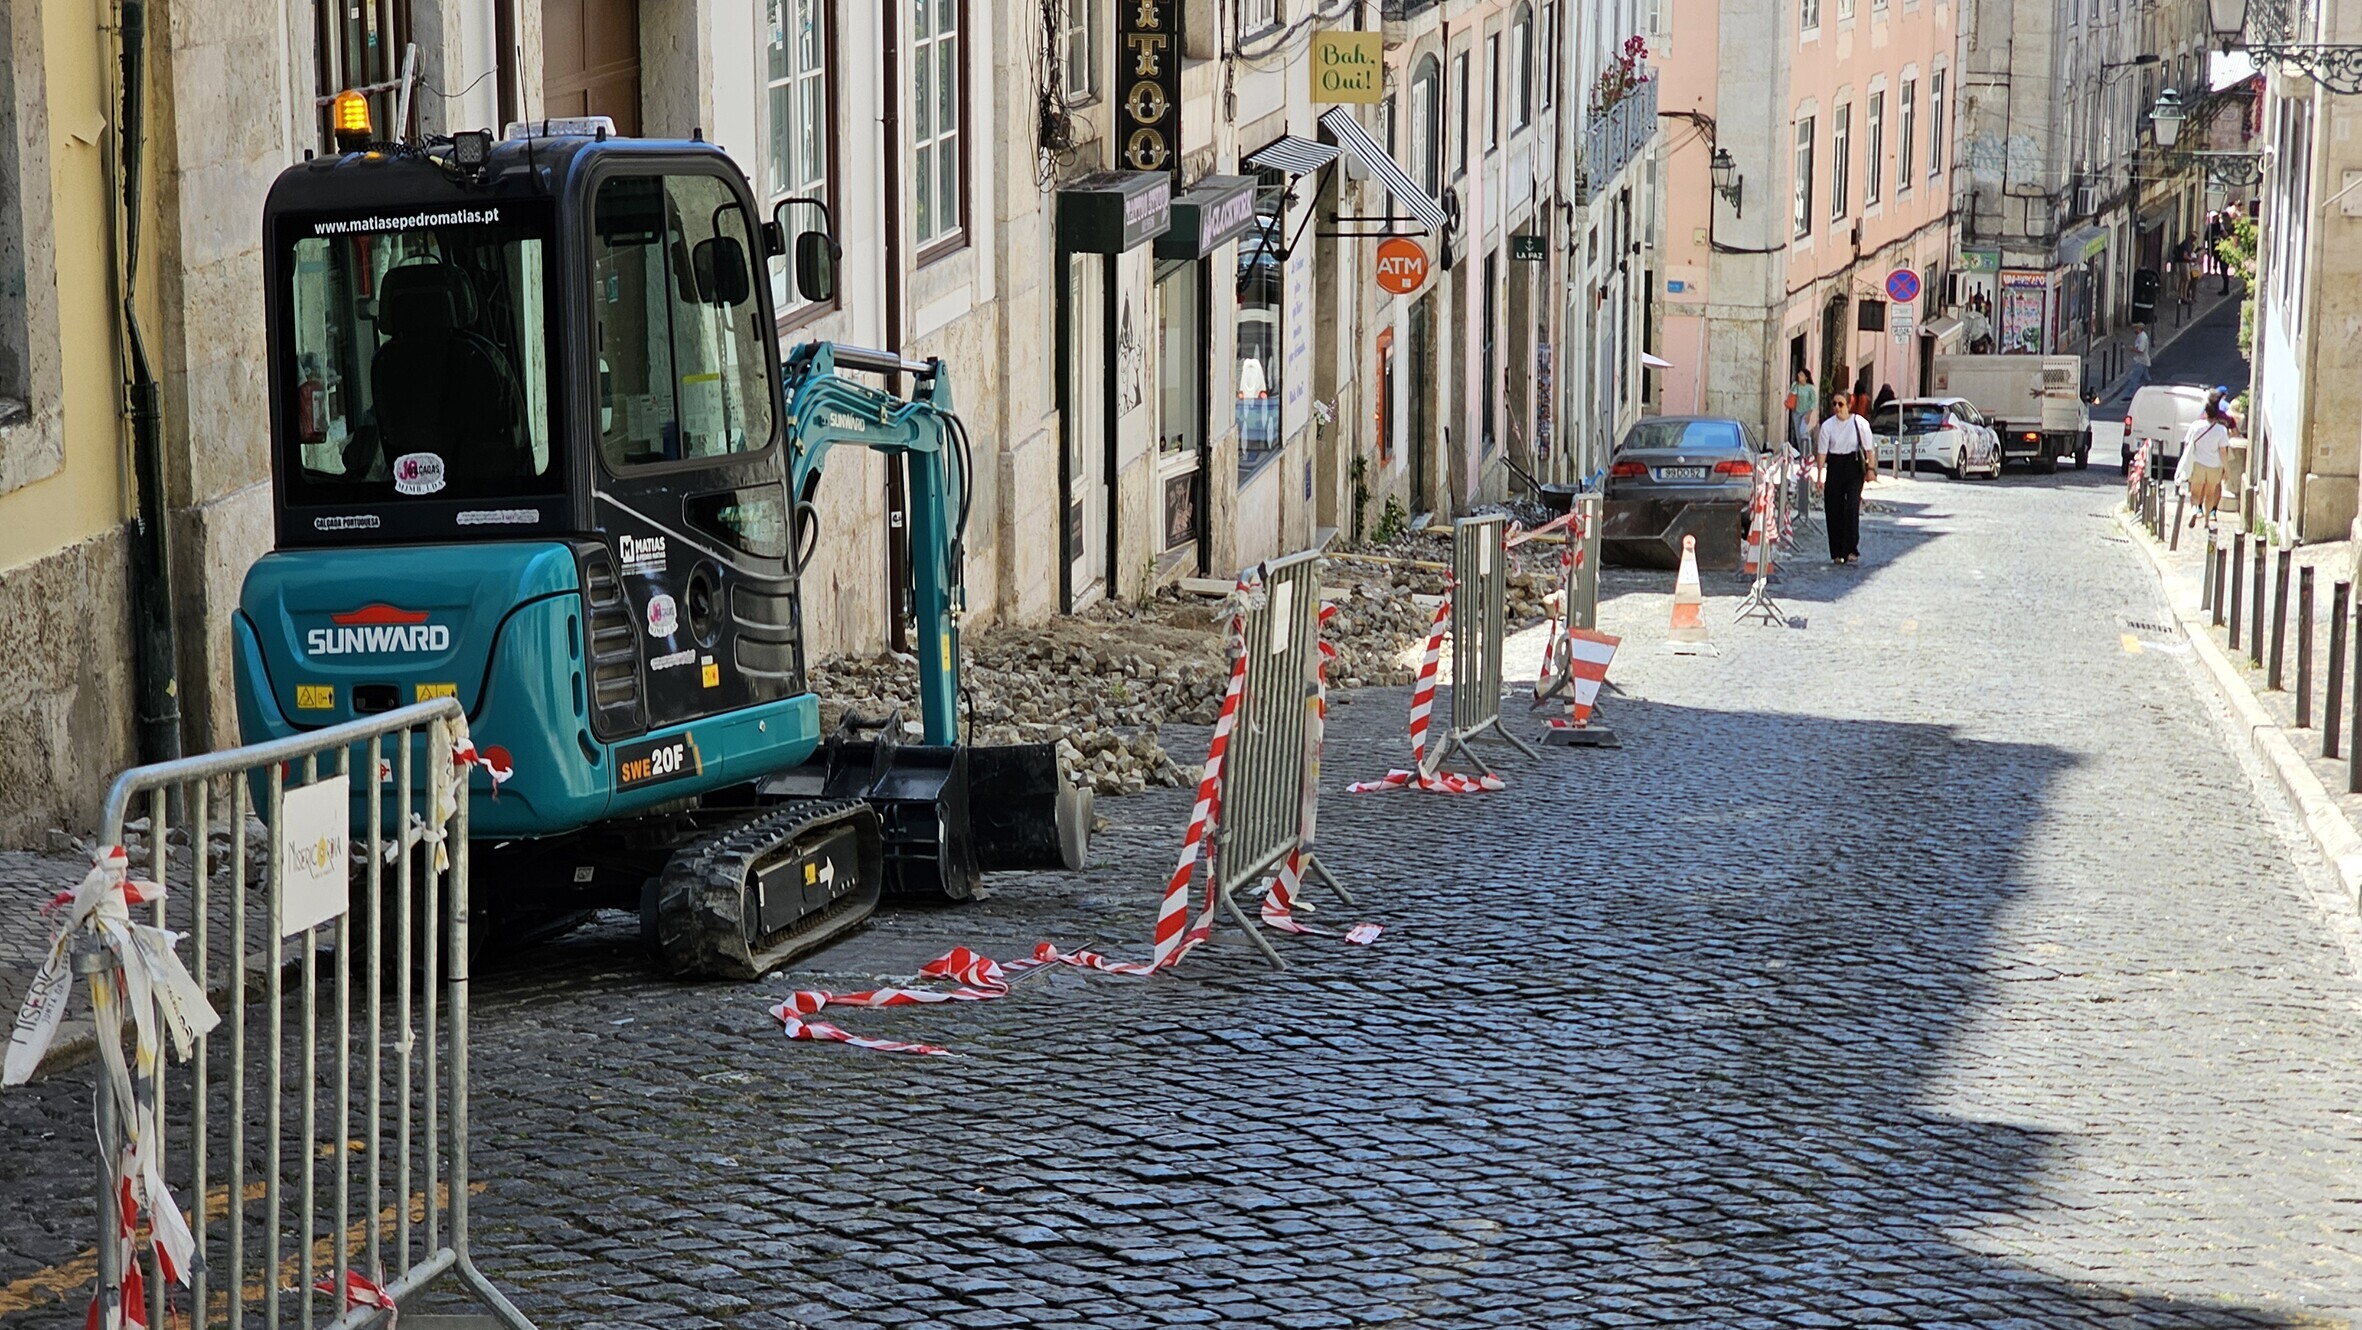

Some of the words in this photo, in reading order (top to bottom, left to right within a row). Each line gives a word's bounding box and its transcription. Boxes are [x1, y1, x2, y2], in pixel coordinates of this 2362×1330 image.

[1318, 43, 1376, 68] Bah,
[1322, 69, 1371, 91] Oui!
[314, 207, 500, 234] www.matiasepedromatias.pt
[1377, 257, 1422, 275] ATM
[830, 412, 866, 432] SUNWARD
[635, 536, 666, 553] MATIAS
[308, 625, 449, 655] SUNWARD
